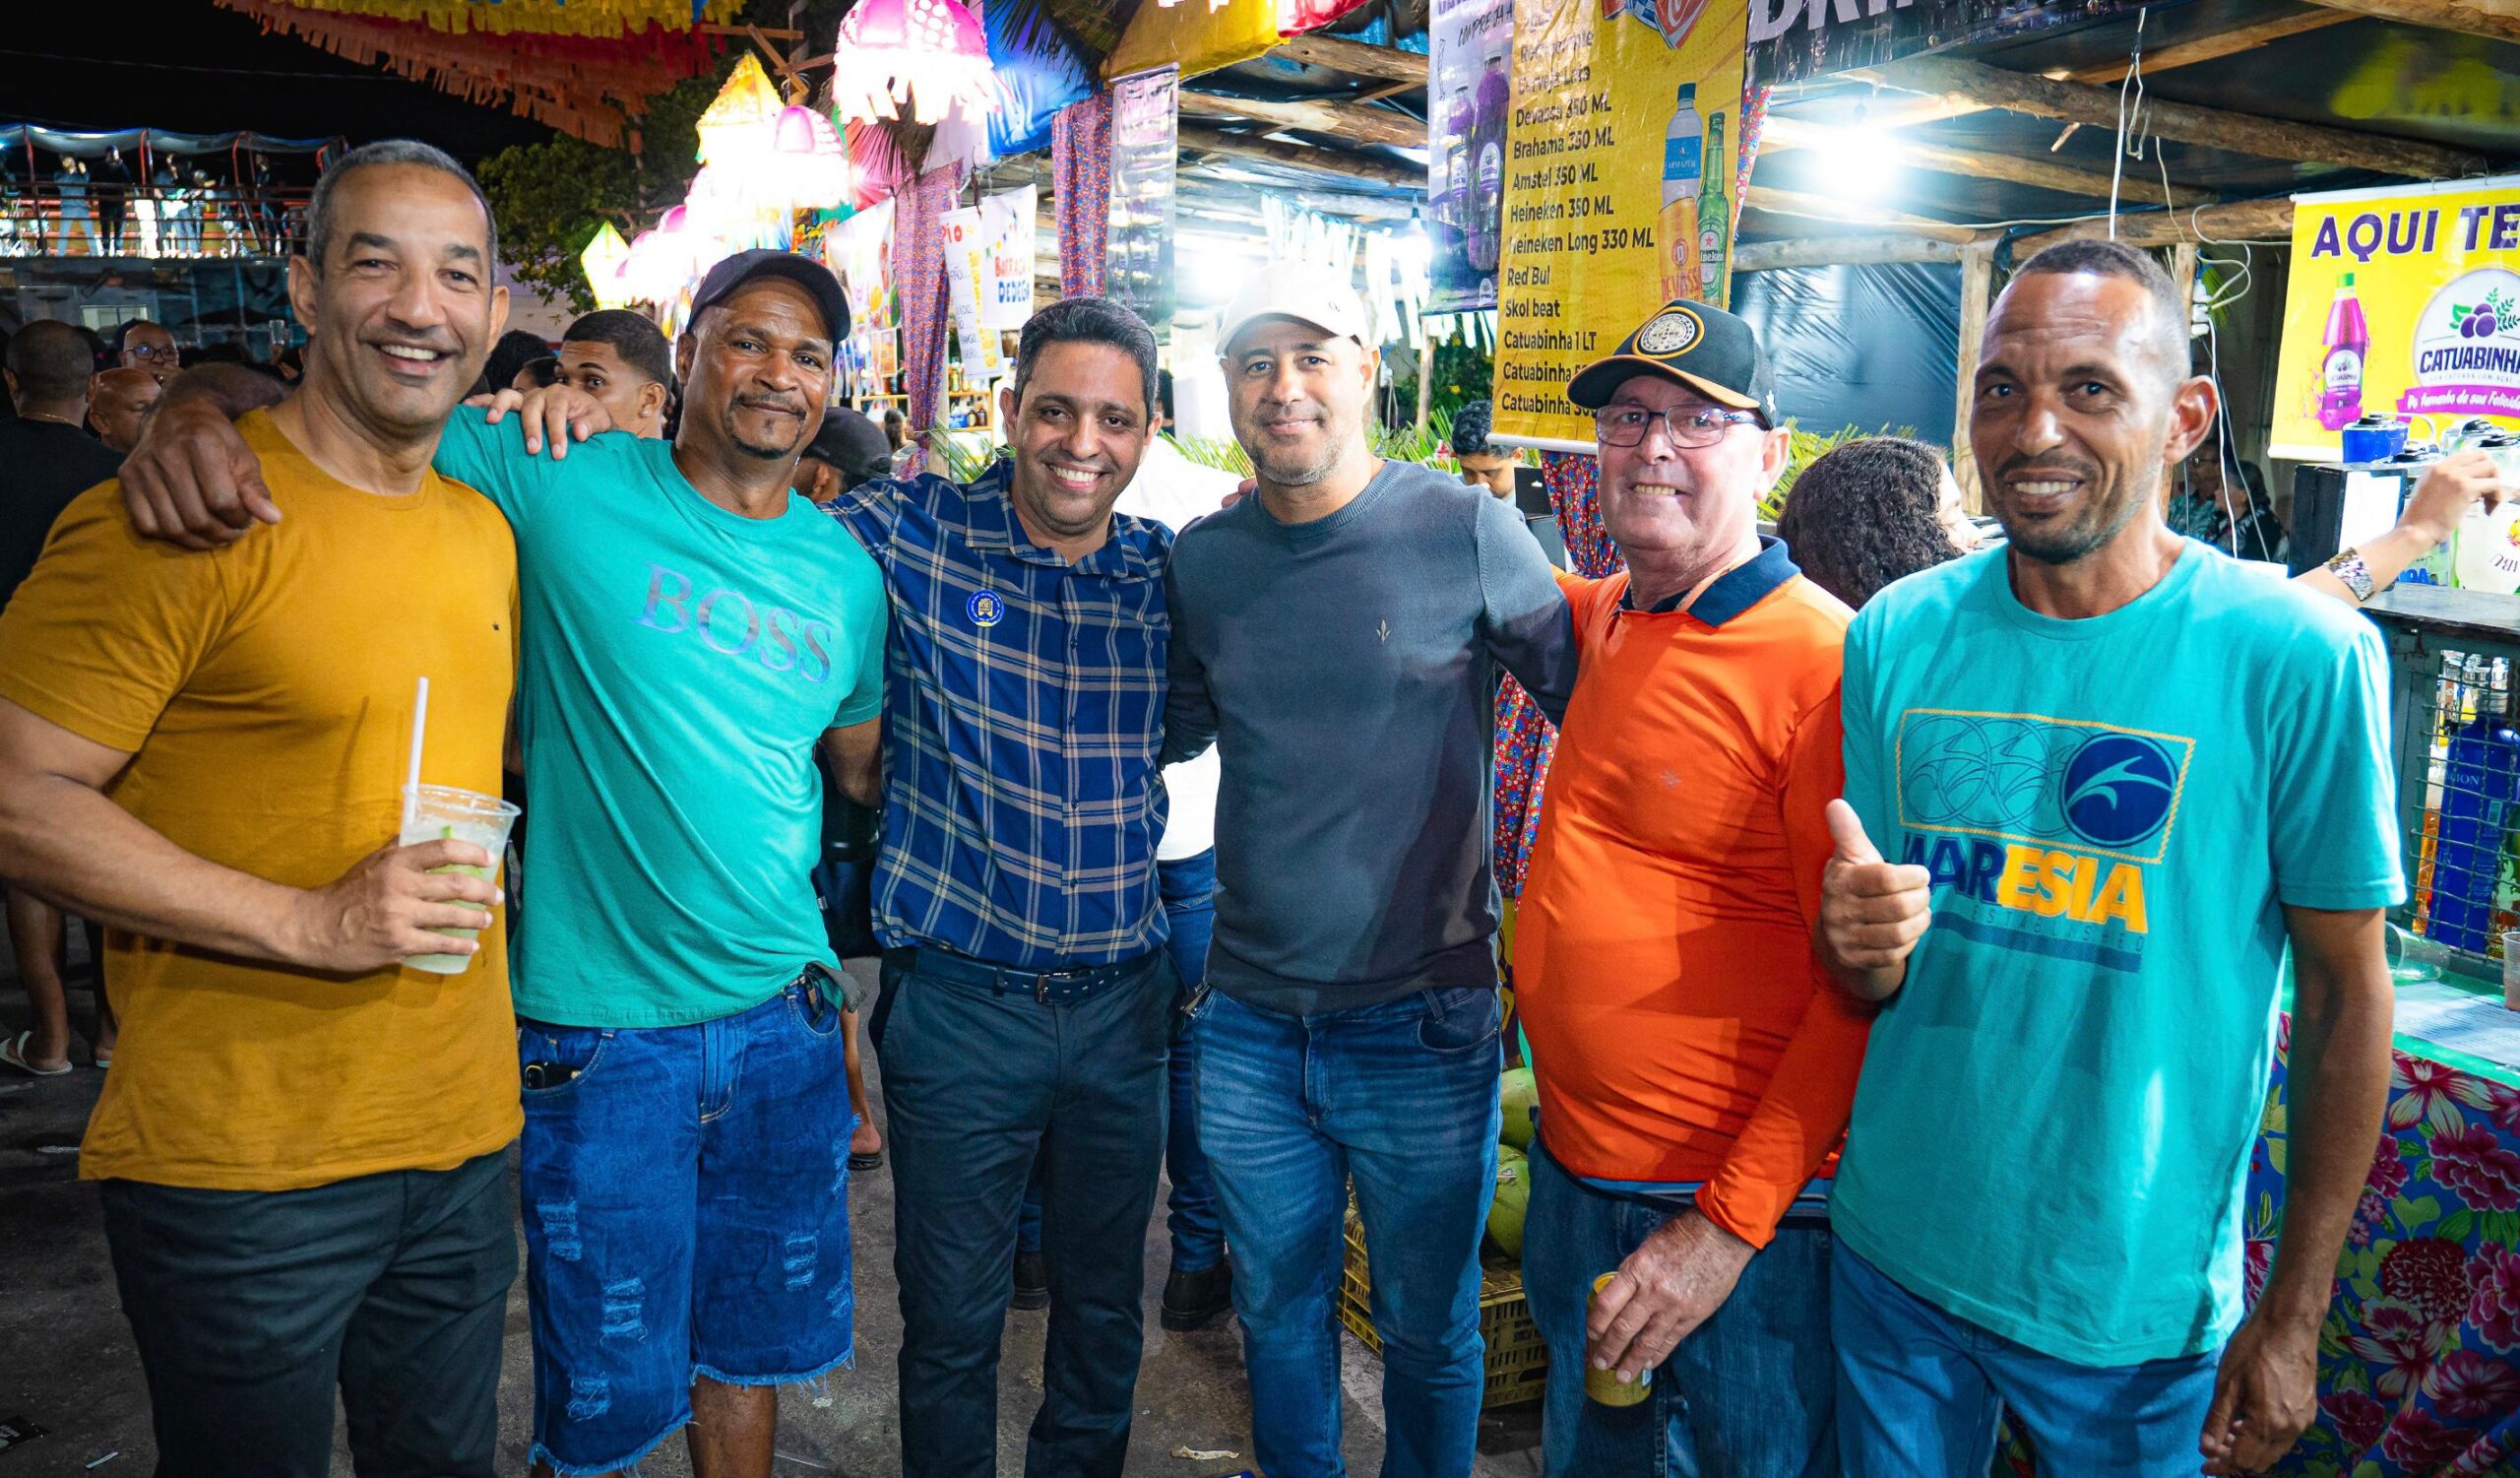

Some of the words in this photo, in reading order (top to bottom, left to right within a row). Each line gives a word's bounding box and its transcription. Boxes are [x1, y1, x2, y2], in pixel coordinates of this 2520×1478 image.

[1516, 104, 1563, 127] Devassa
[1566, 98, 1587, 119] 350
[1592, 94, 1612, 113] ML
[1513, 137, 1564, 160] Brahama
[1567, 130, 1590, 151] 350
[1594, 126, 1615, 148] ML
[1512, 166, 1552, 191] Amstel
[1554, 164, 1576, 186] 350
[1579, 162, 1599, 183] ML
[1510, 200, 1564, 223] Heineken
[1567, 197, 1591, 219] 350
[1594, 195, 1614, 216] ML
[1567, 232, 1599, 256] Long
[1602, 228, 1628, 250] 330
[1632, 227, 1655, 248] ML
[2310, 209, 2440, 263] AQUI
[1507, 267, 1529, 287] Red
[1532, 265, 1550, 286] Bul
[1505, 298, 1530, 318] Skol
[1532, 298, 1561, 318] beat
[1504, 329, 1573, 352] Catuabinha
[1582, 331, 1597, 352] LT
[1502, 361, 1572, 383] Catuabinha
[1501, 392, 1572, 416] Catuabinha
[631, 561, 832, 683] BOSS
